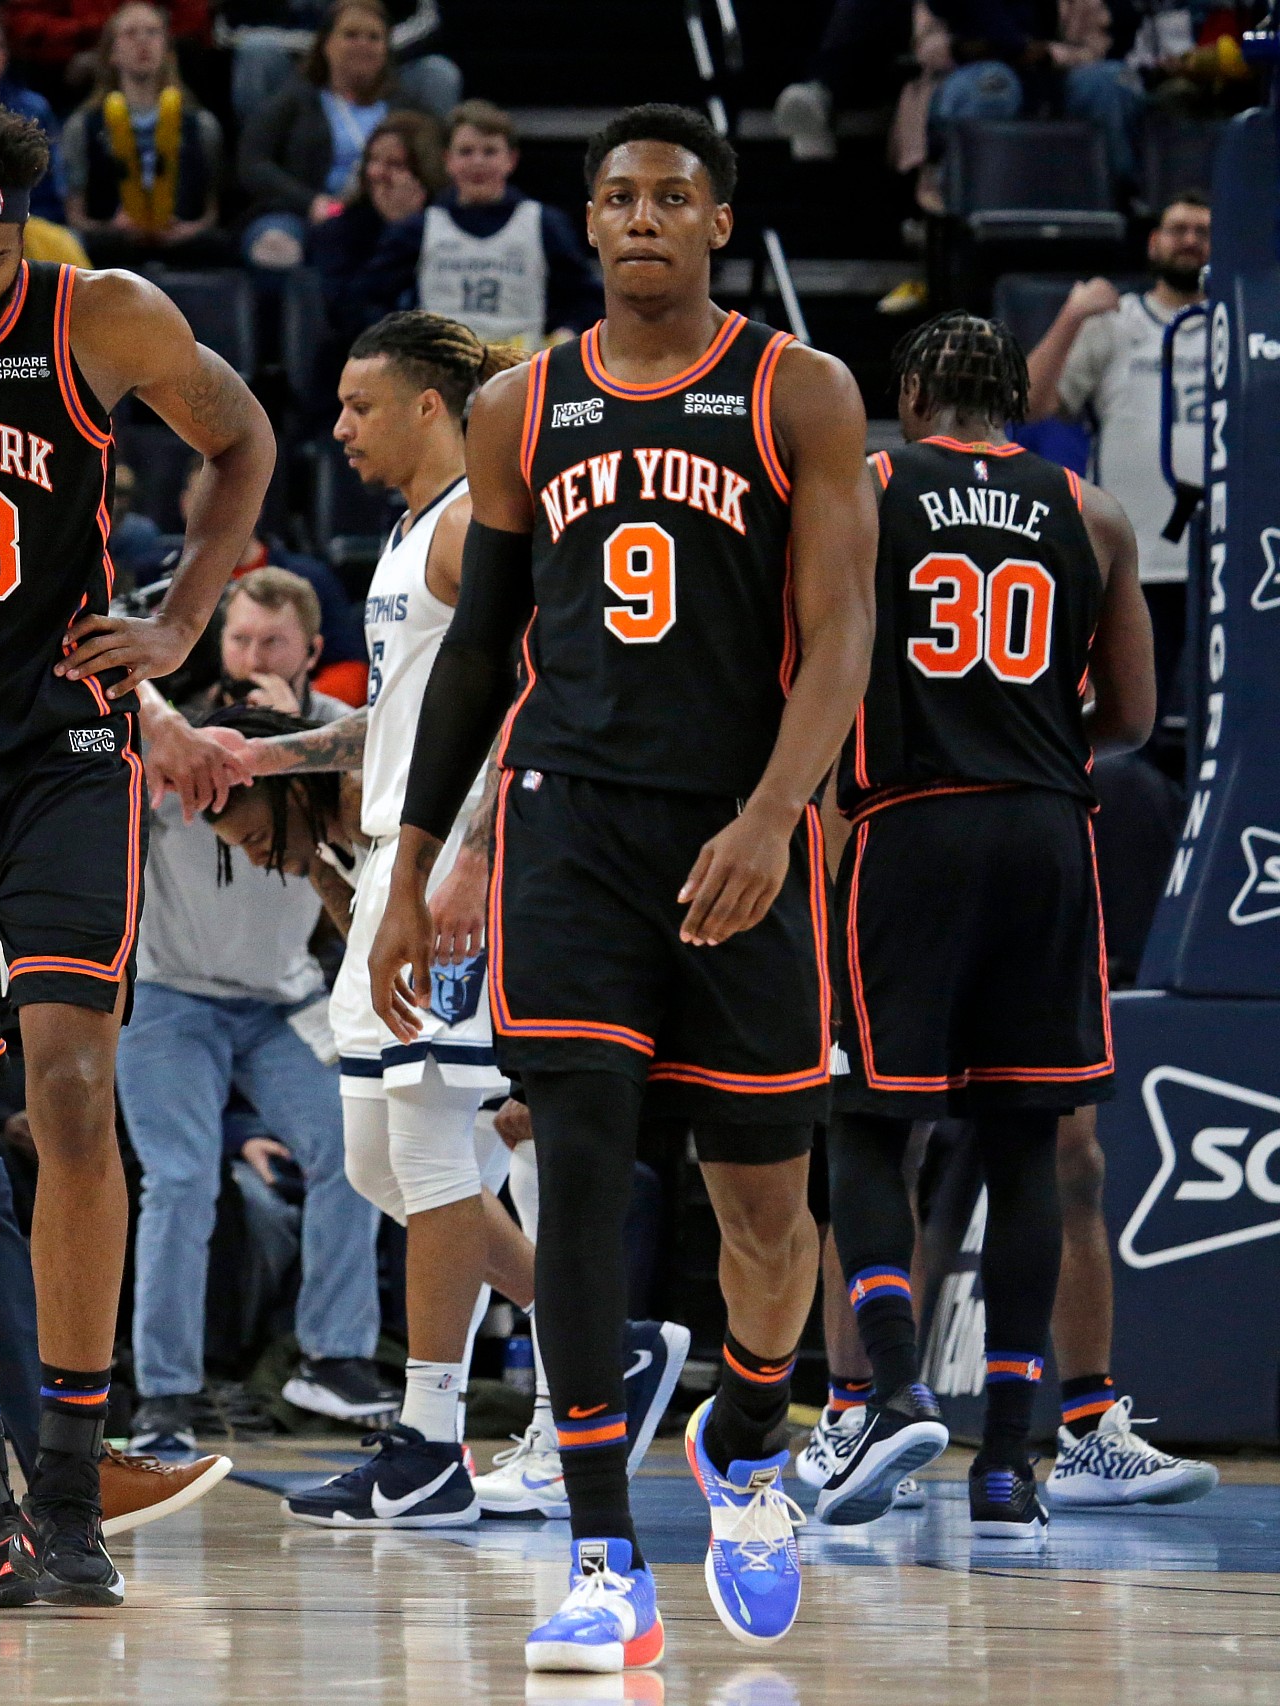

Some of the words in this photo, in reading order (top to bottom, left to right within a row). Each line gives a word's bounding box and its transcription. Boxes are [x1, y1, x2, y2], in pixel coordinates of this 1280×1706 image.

[462, 277, 500, 313] 12
[684, 404, 732, 415] SPACE
[685, 393, 745, 405] SQUARE
[540, 450, 622, 544] NEW
[633, 448, 750, 536] YORK
[918, 487, 1050, 542] RANDLE
[603, 521, 677, 644] 9
[907, 552, 1056, 685] 30
